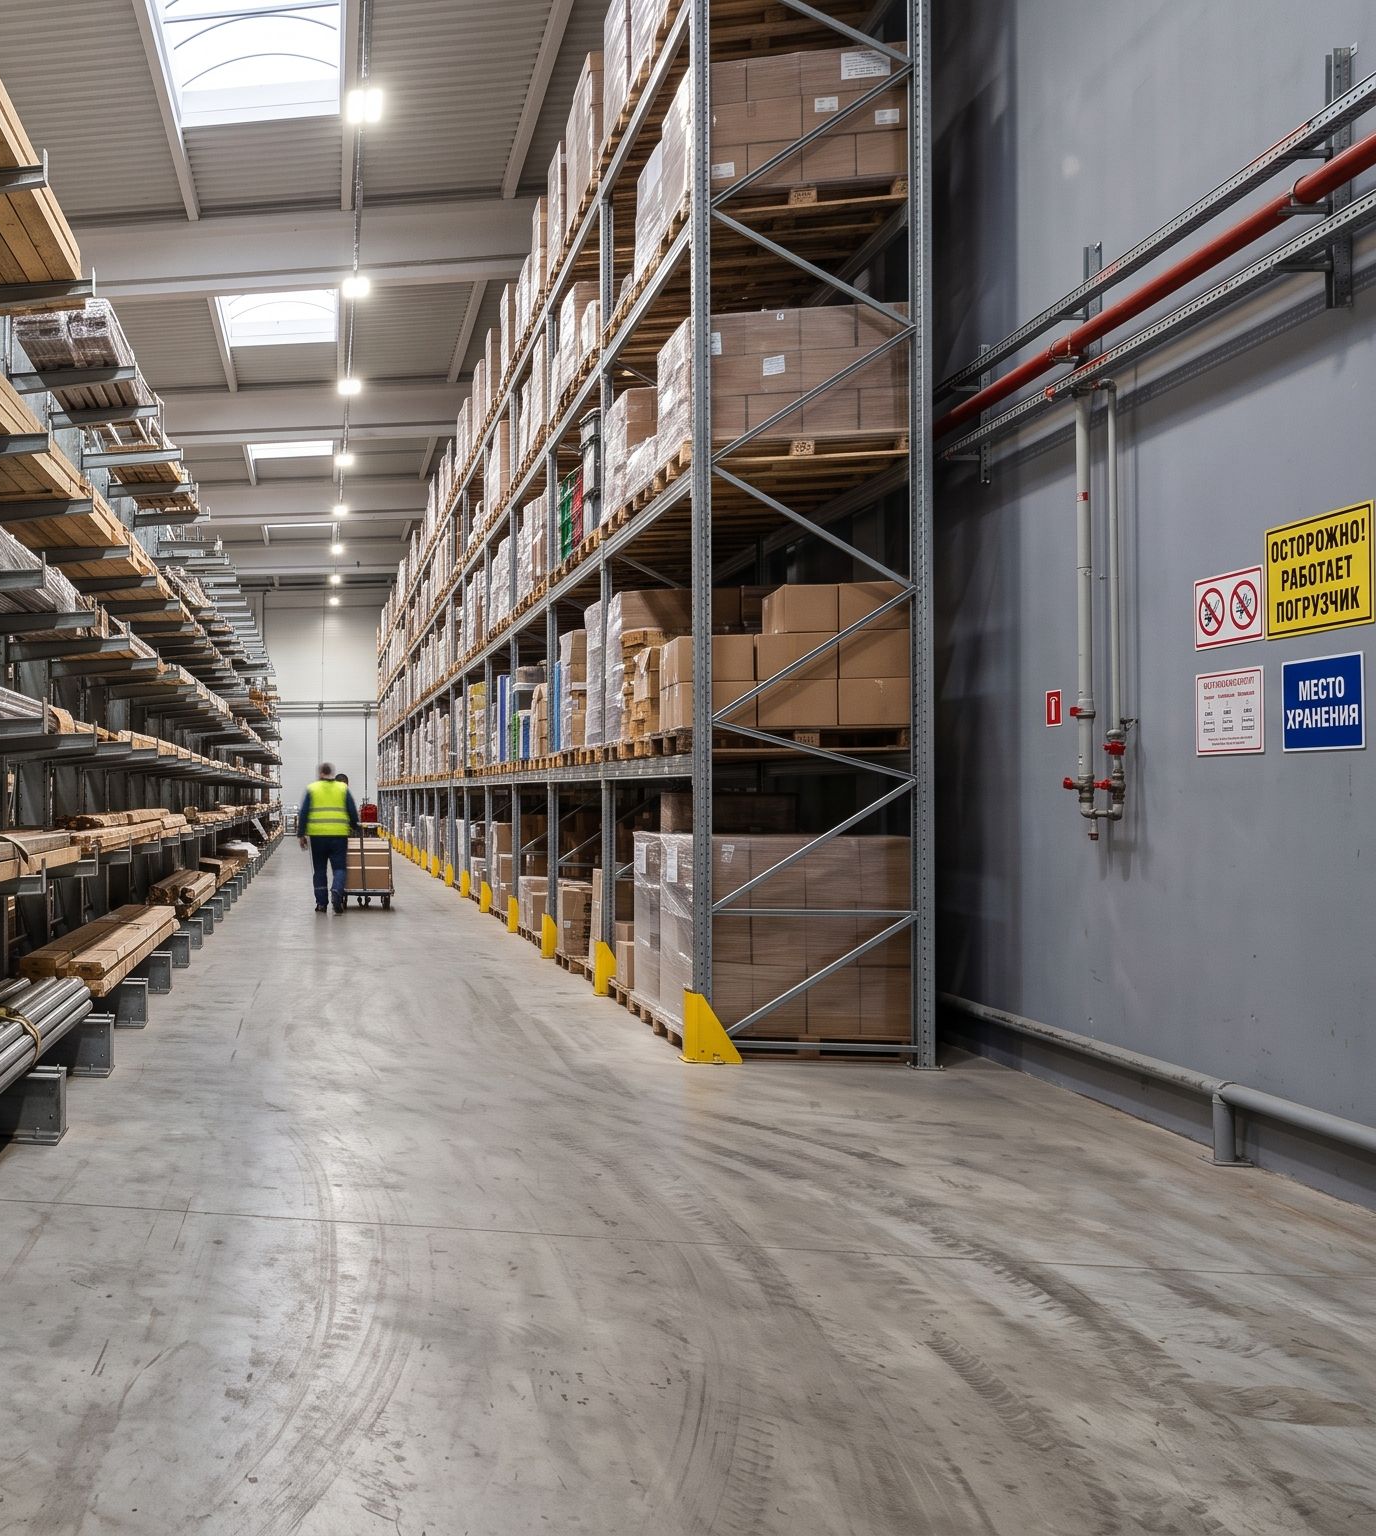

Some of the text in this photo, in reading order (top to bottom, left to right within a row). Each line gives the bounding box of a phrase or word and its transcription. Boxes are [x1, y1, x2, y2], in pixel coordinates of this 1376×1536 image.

[1271, 517, 1365, 563] ОСТОРОЖНО!
[1281, 554, 1353, 592] РАБОТАЕТ
[1276, 585, 1360, 624] ПОГРУЗЧИК
[1298, 676, 1345, 702] МЕСТО
[1286, 703, 1359, 730] ХРАНЕНИЯ
